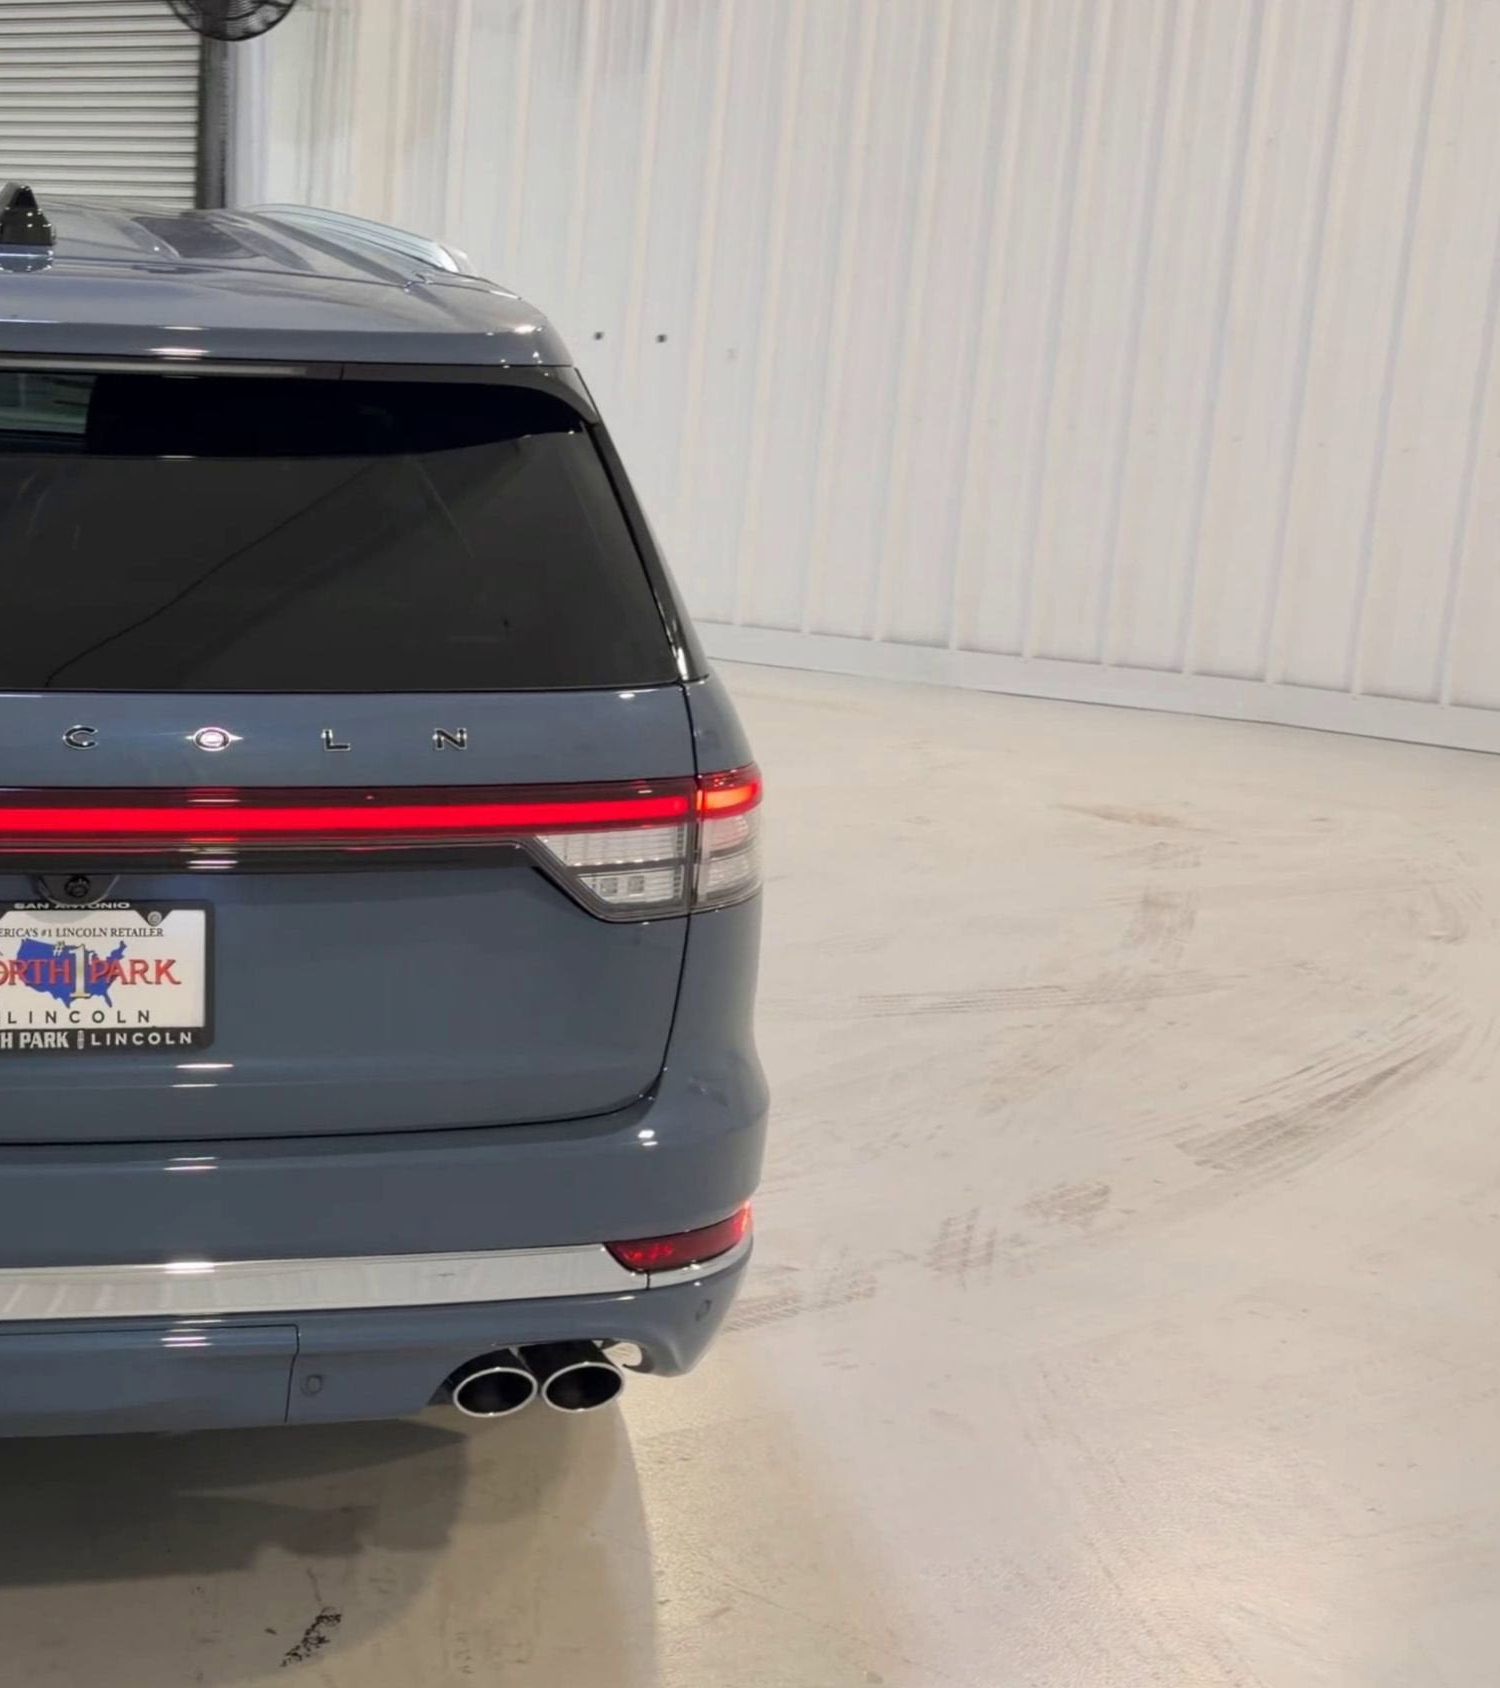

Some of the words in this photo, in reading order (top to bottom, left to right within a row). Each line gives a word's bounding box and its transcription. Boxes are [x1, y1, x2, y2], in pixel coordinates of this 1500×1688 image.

[14, 902, 50, 910] SAN
[56, 927, 108, 938] LINCOLN
[110, 928, 165, 938] RETAILER
[90, 959, 182, 986] PARK
[7, 1010, 151, 1025] LINCOLN
[19, 1031, 70, 1049] PARK
[91, 1032, 193, 1046] LINCOLN
